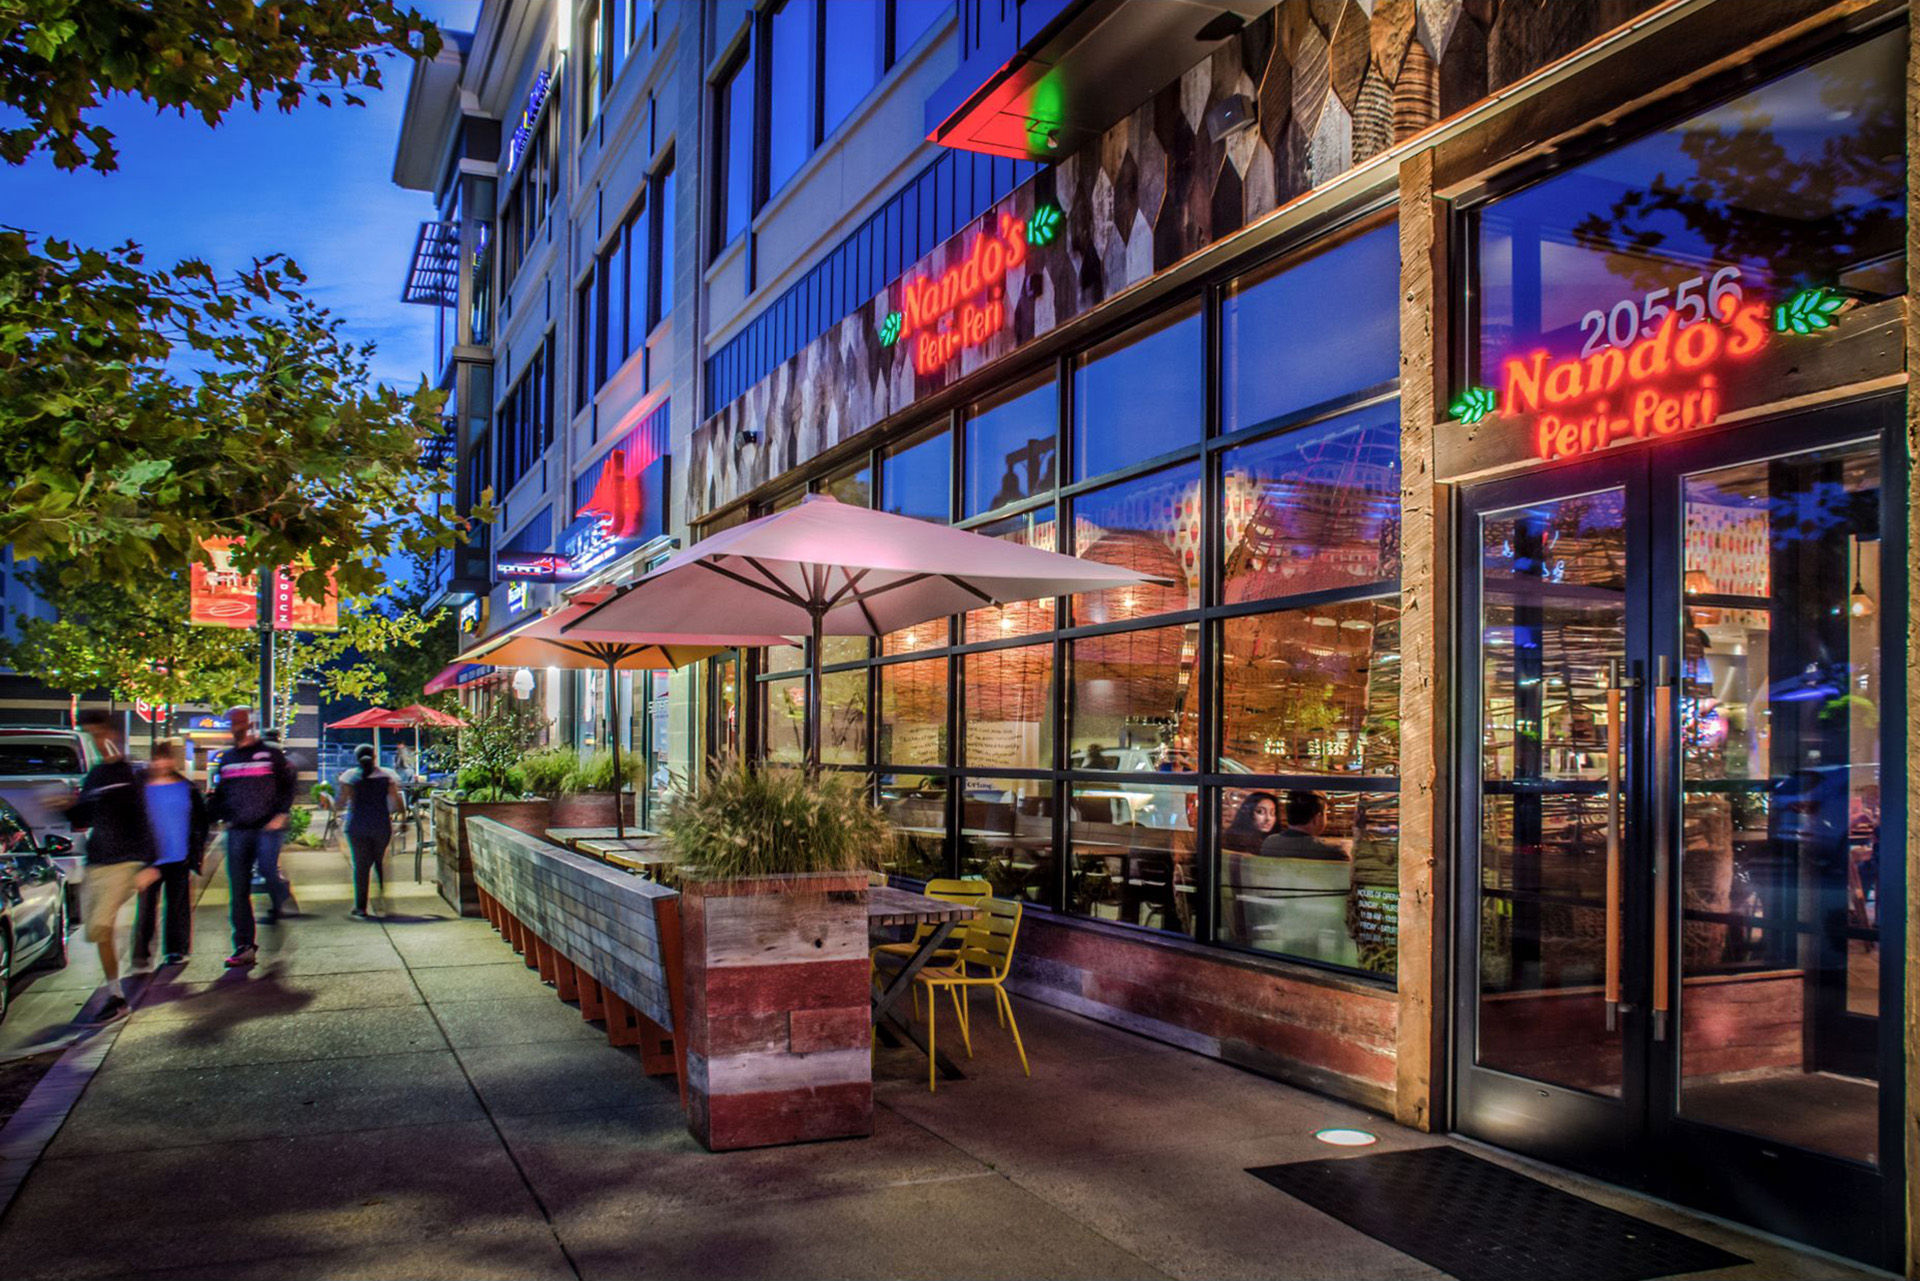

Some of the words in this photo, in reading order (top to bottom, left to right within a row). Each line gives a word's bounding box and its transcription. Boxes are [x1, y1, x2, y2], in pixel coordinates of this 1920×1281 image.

[901, 213, 1027, 338] Nando's
[1580, 266, 1743, 359] 20556
[917, 288, 1004, 374] Peri-Peri
[1502, 294, 1771, 418] Nando's
[1538, 376, 1719, 459] Peri-Peri
